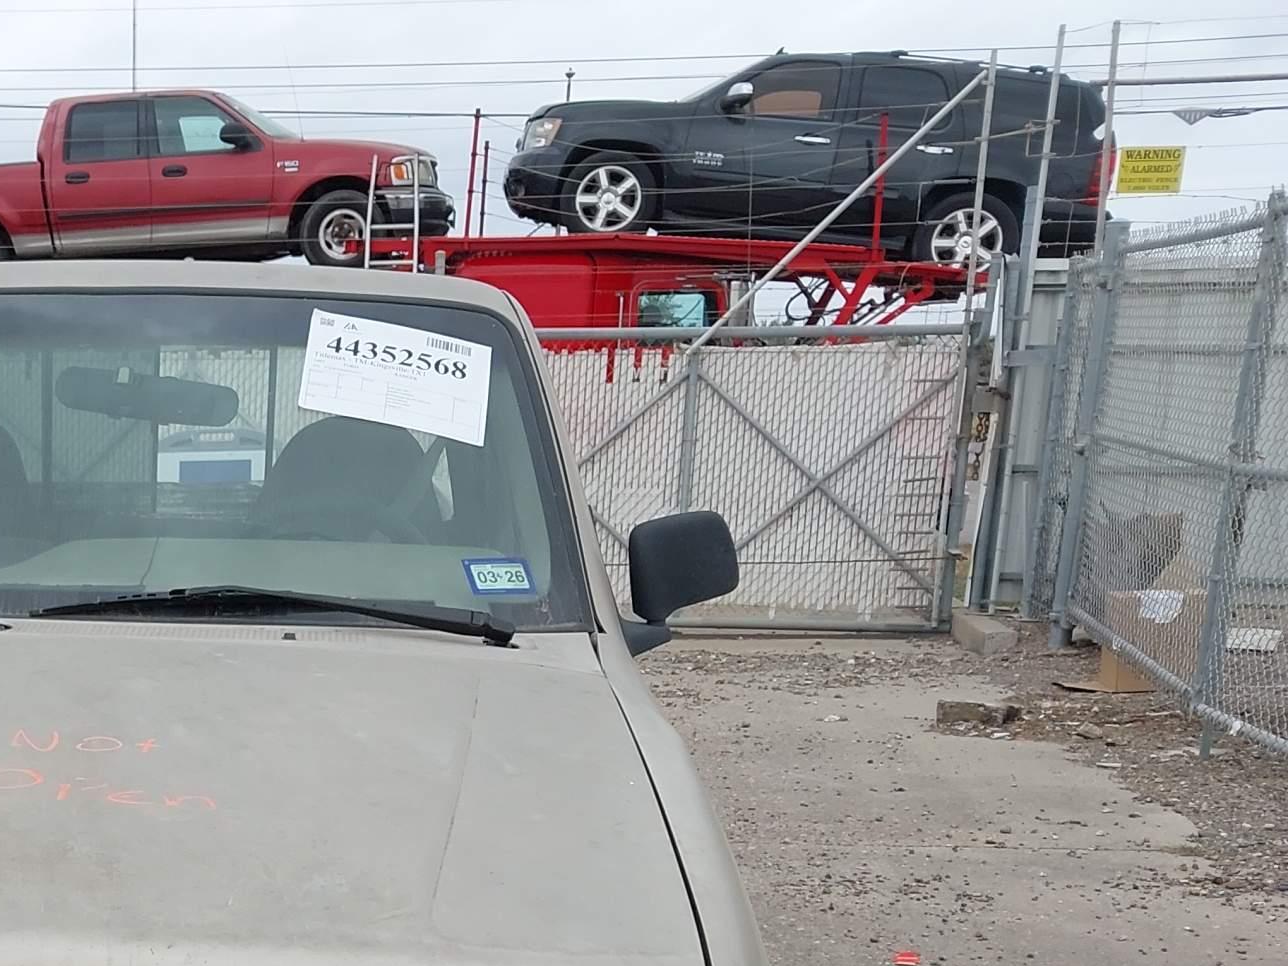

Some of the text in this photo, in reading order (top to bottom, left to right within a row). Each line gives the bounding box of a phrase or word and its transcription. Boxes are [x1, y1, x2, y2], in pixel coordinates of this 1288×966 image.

[1125, 149, 1181, 160] WARNING
[1130, 165, 1174, 174] ALARMED
[326, 336, 467, 380] 44352568
